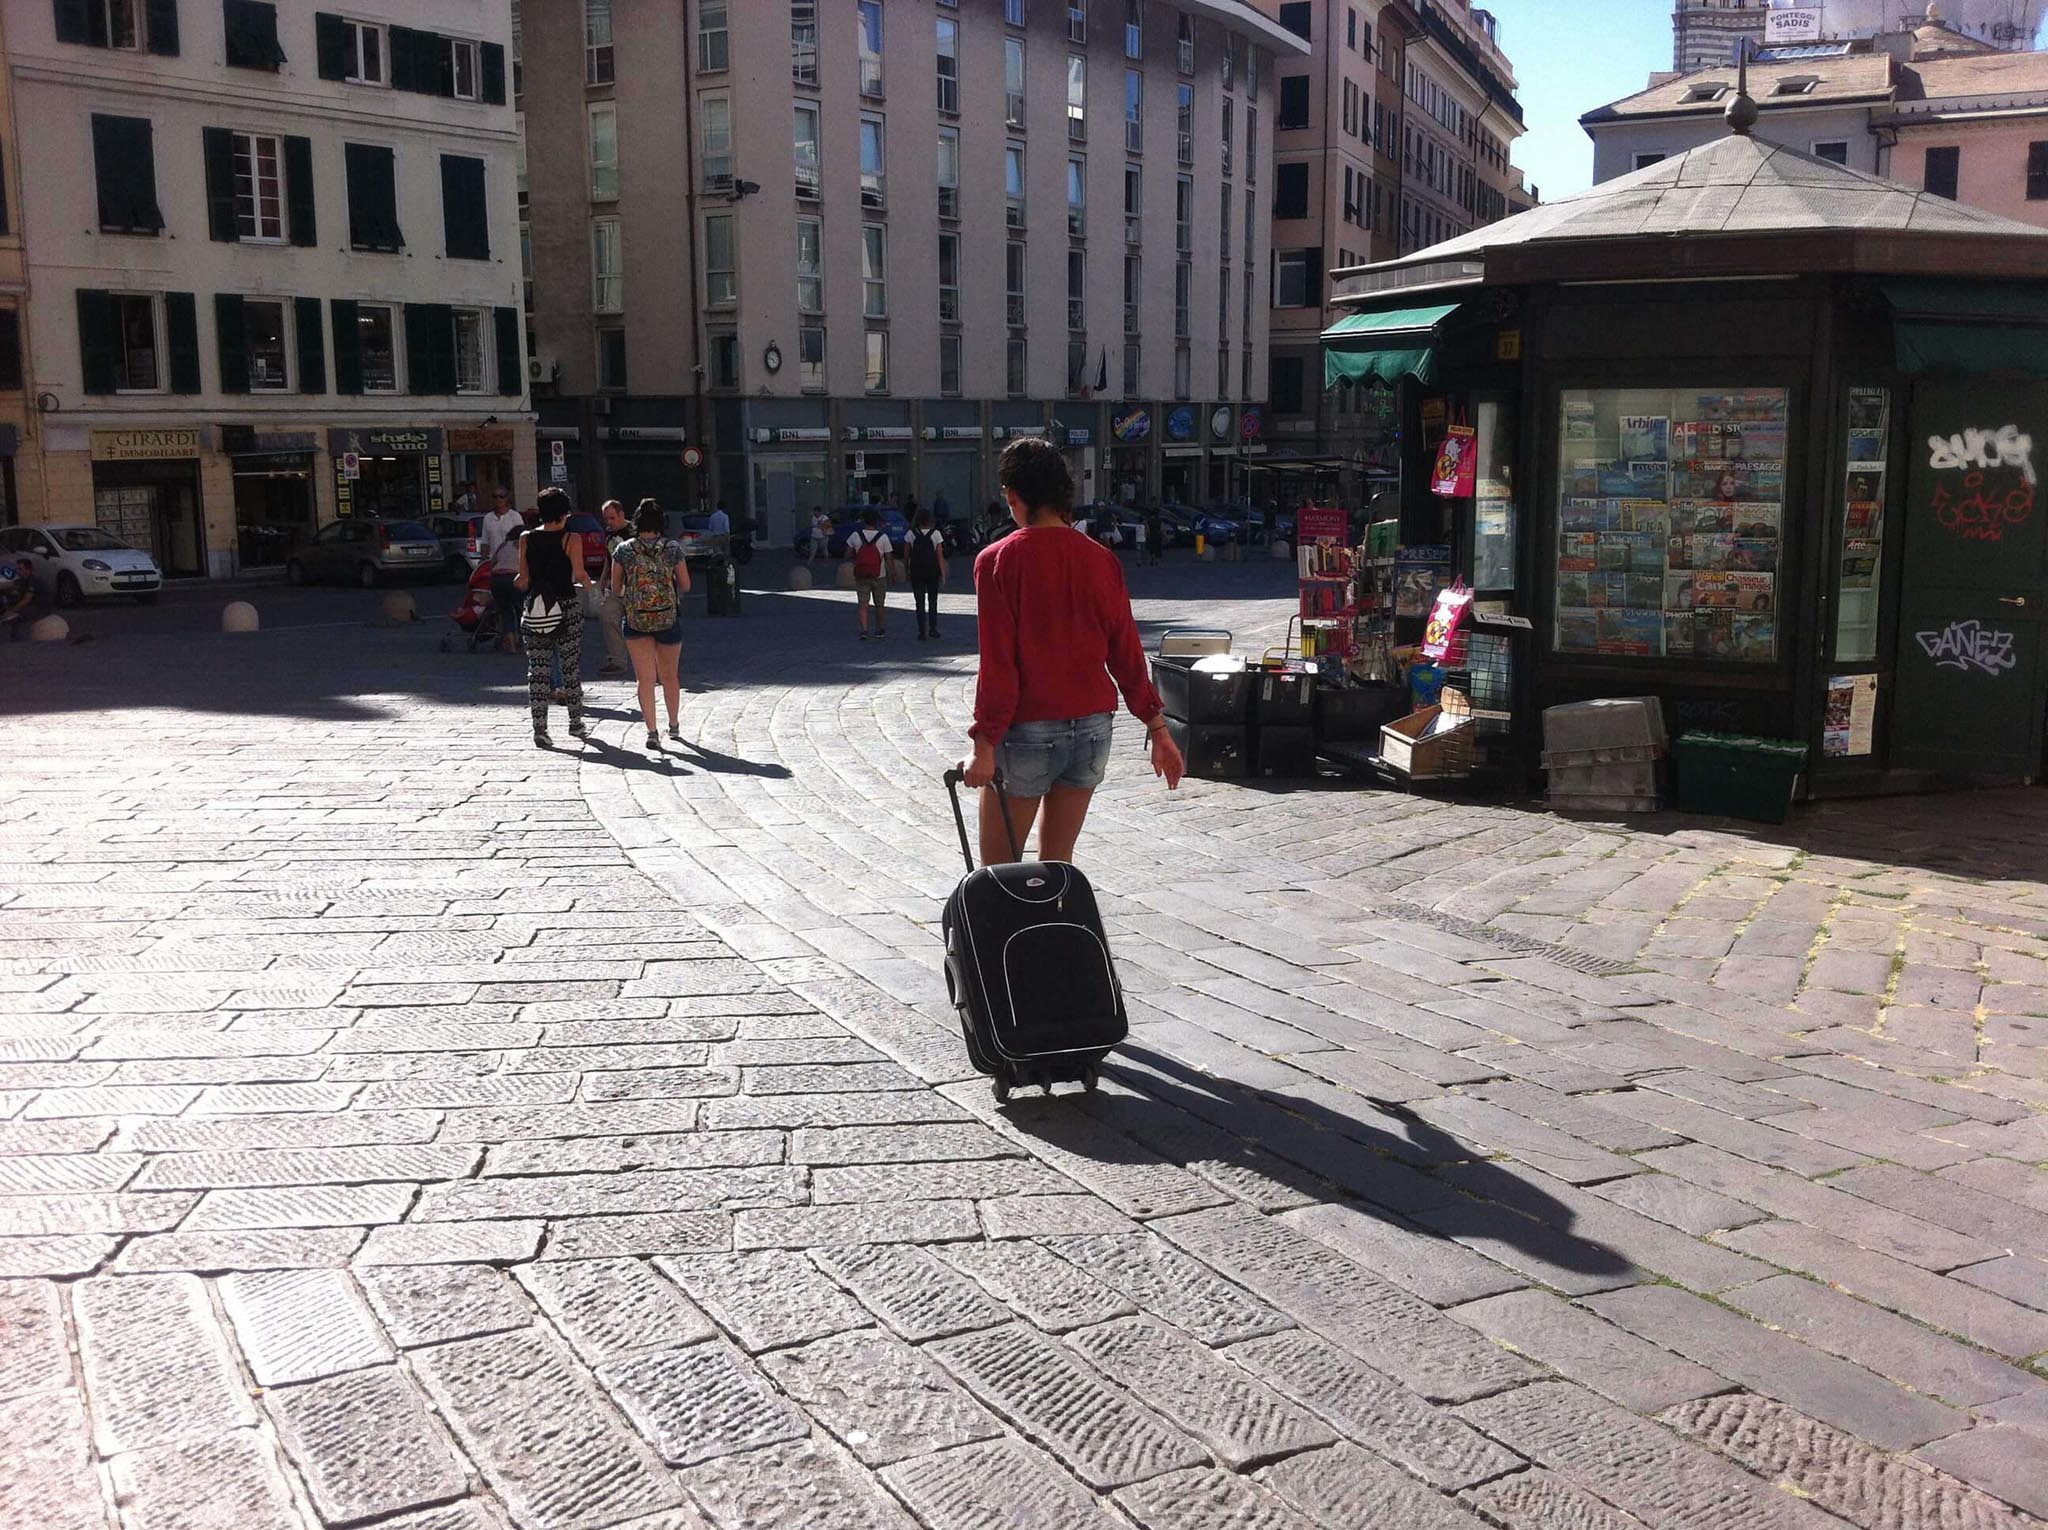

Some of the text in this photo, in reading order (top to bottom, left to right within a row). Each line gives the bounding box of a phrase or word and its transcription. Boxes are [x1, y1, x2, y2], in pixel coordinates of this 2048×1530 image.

[1770, 12, 1816, 23] PONTEGGI
[1775, 19, 1810, 29] SADIS
[370, 432, 428, 443] studio
[781, 430, 800, 439] BNL
[869, 429, 886, 438] BNL
[116, 433, 196, 446] GIRARDI
[389, 442, 429, 451] uno
[119, 448, 194, 457] IMMOBILIARE
